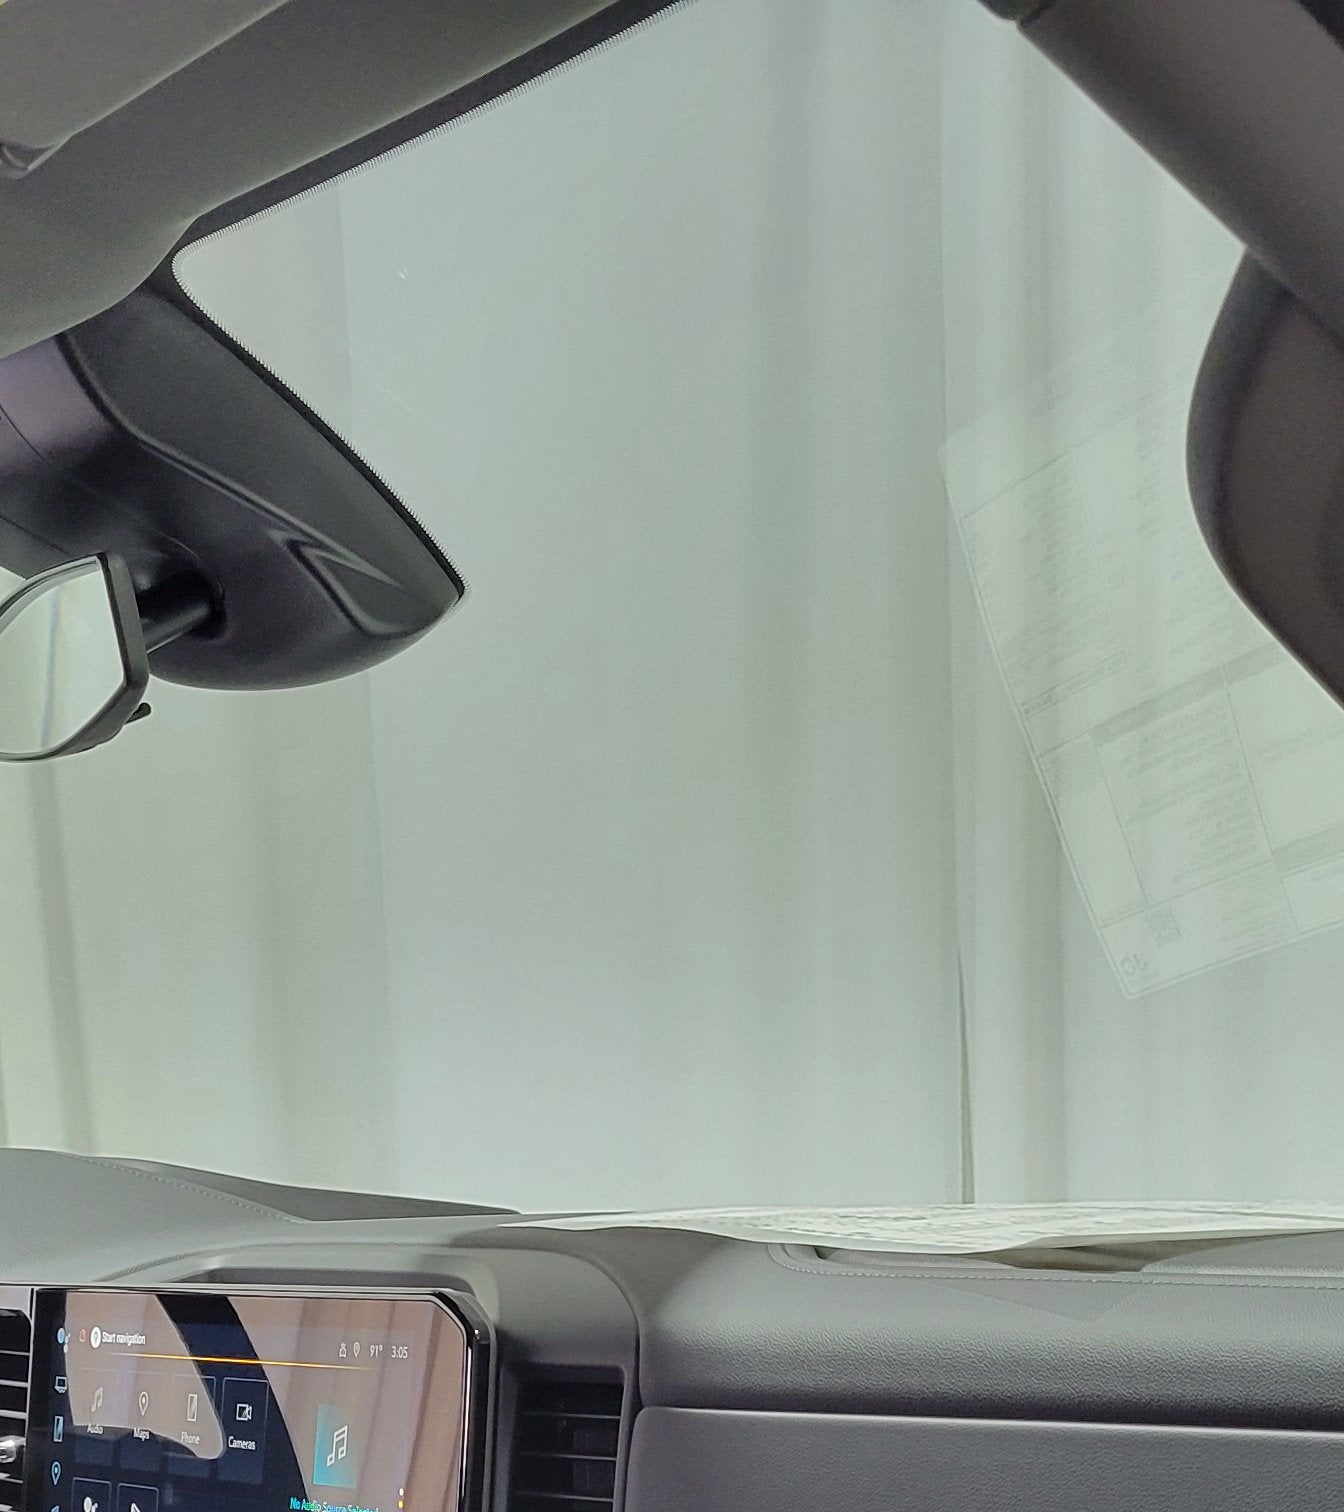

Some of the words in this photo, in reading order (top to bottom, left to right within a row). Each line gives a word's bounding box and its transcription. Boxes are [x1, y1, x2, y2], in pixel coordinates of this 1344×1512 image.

[102, 1331, 116, 1343] Start
[116, 1333, 146, 1347] navigation
[369, 1344, 383, 1357] 91°
[391, 1345, 408, 1358] 3:05
[87, 1424, 103, 1435] Audio
[133, 1427, 150, 1442] Maps
[181, 1431, 200, 1444] Phone
[228, 1436, 256, 1450] Cameras
[289, 1497, 301, 1510] No
[301, 1498, 321, 1512] Audio
